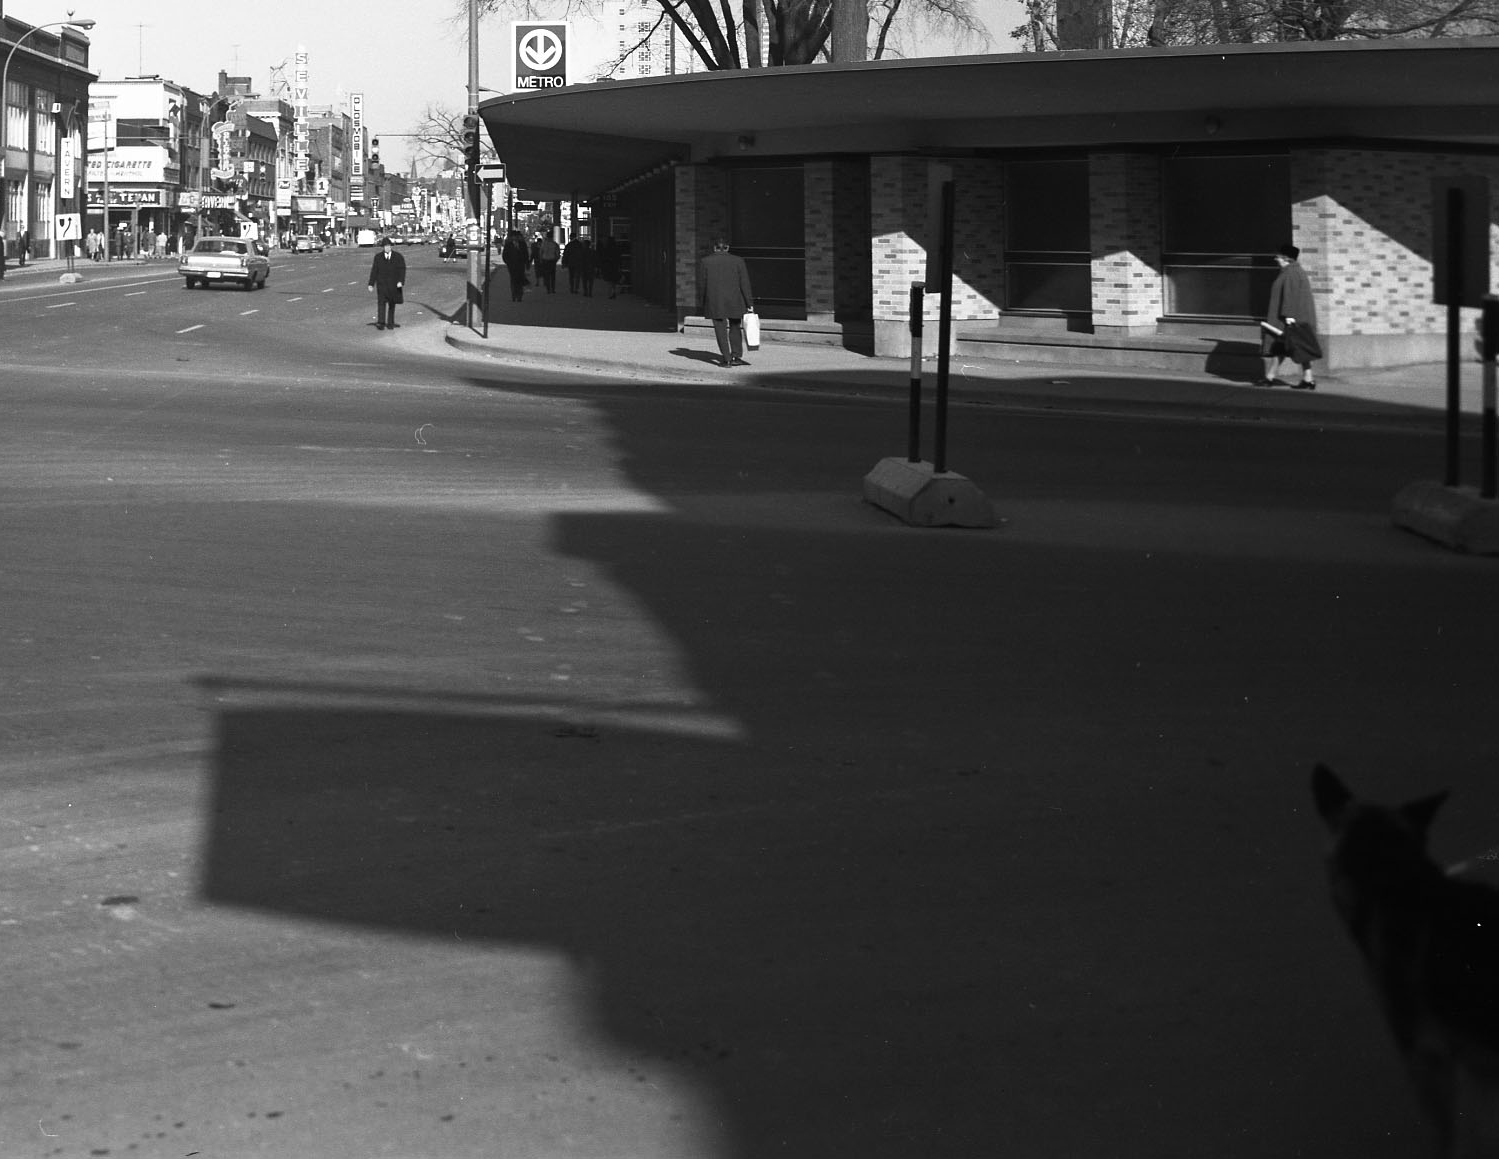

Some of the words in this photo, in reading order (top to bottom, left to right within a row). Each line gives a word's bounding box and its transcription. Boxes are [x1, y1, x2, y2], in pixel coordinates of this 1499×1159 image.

[517, 76, 564, 88] METRO
[296, 53, 308, 171] SEVILLE
[353, 97, 361, 173] OLDSMOBILE
[107, 160, 153, 169] CIGARETTE
[318, 181, 325, 191] 1
